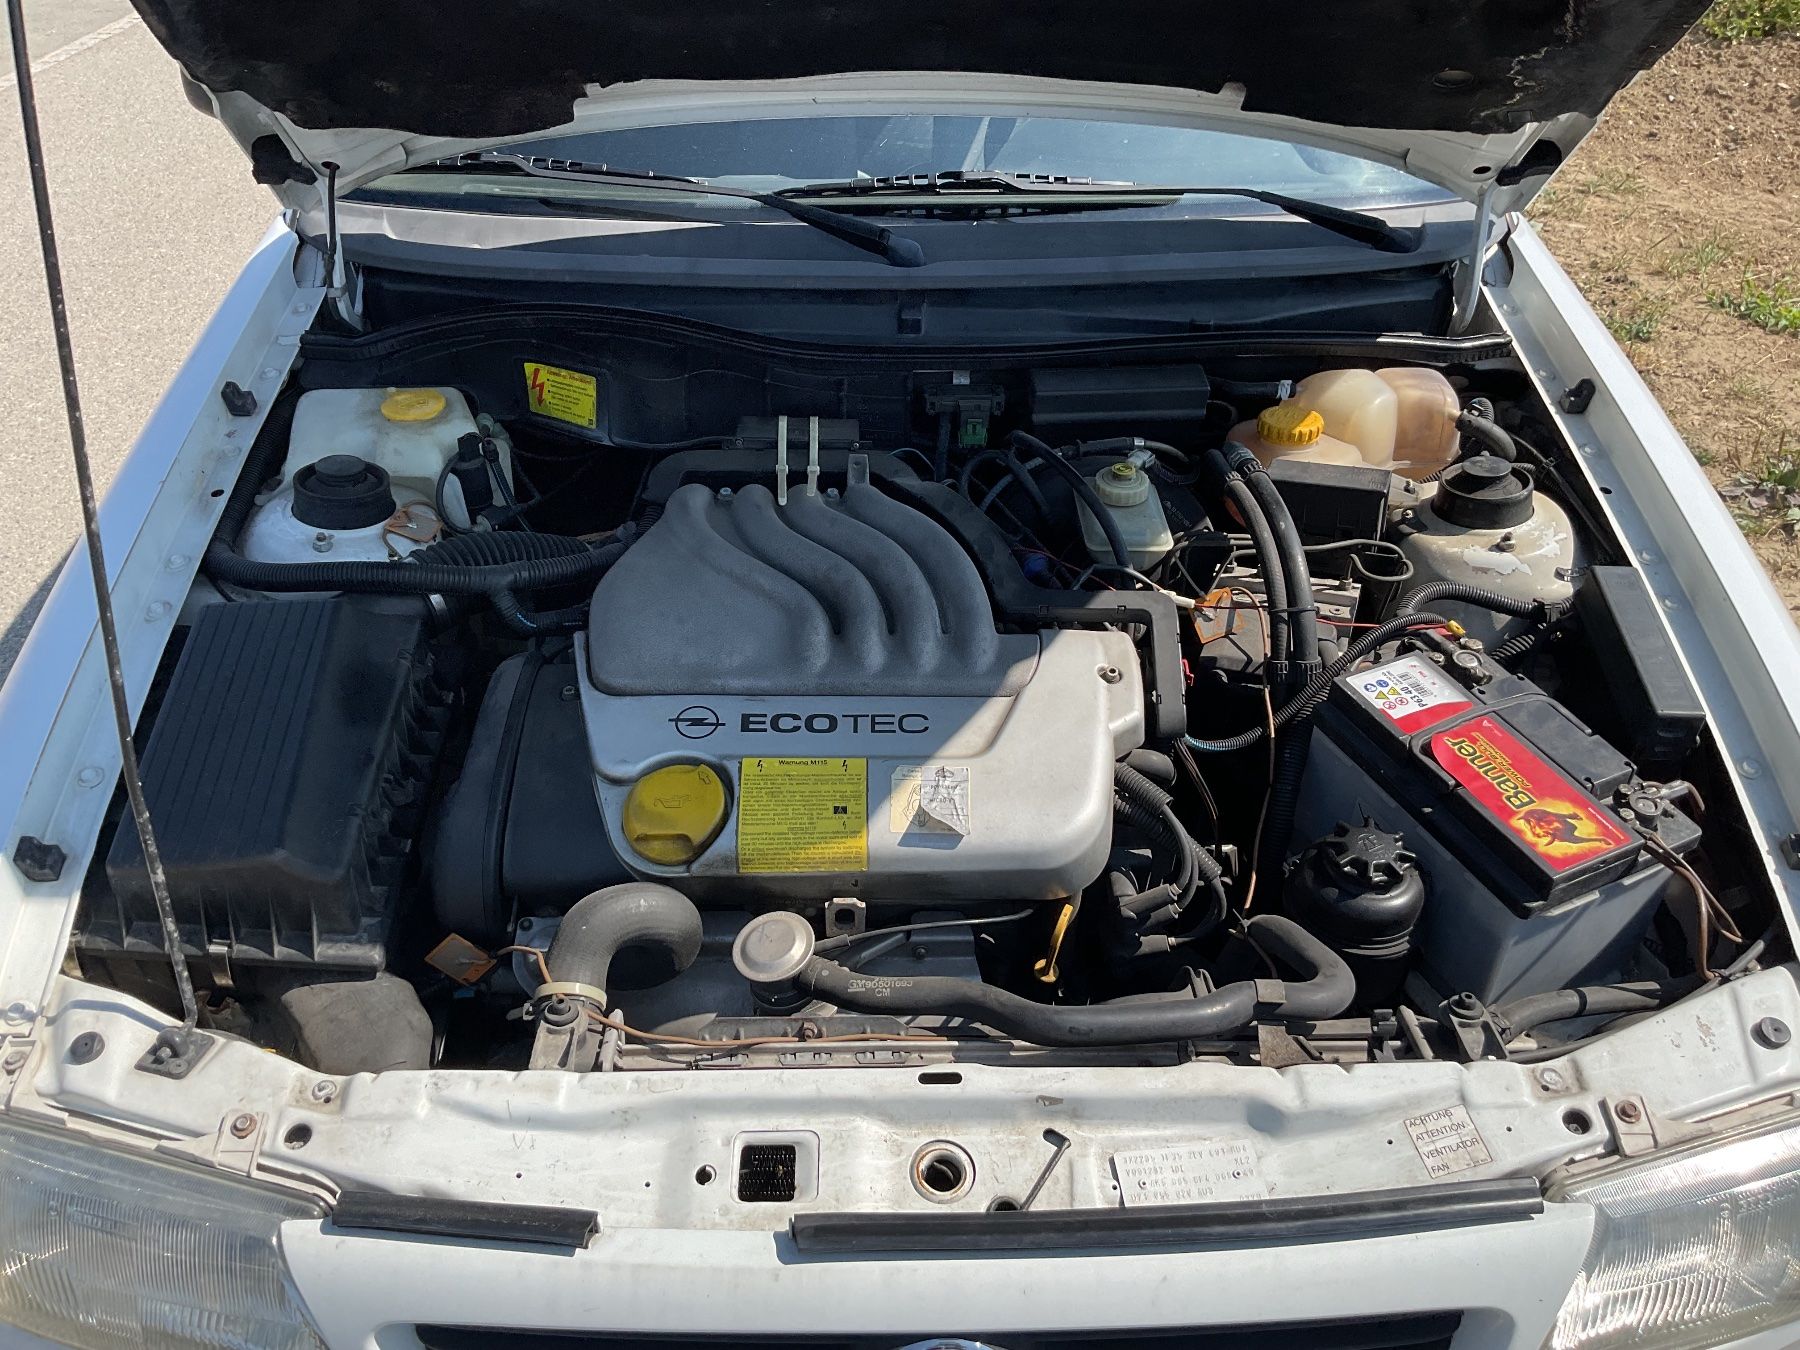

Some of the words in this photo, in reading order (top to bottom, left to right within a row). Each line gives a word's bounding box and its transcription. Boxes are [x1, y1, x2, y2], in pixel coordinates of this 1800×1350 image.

[740, 713, 929, 734] ECOTEC
[1444, 737, 1537, 810] Banner
[1499, 761, 1531, 787] POWER
[875, 987, 890, 997] CM
[1409, 1109, 1453, 1128] ACHTUNG
[1415, 1121, 1466, 1142] ATTENTION
[1423, 1137, 1480, 1160] VENTILATOR
[1430, 1162, 1450, 1175] FAN
